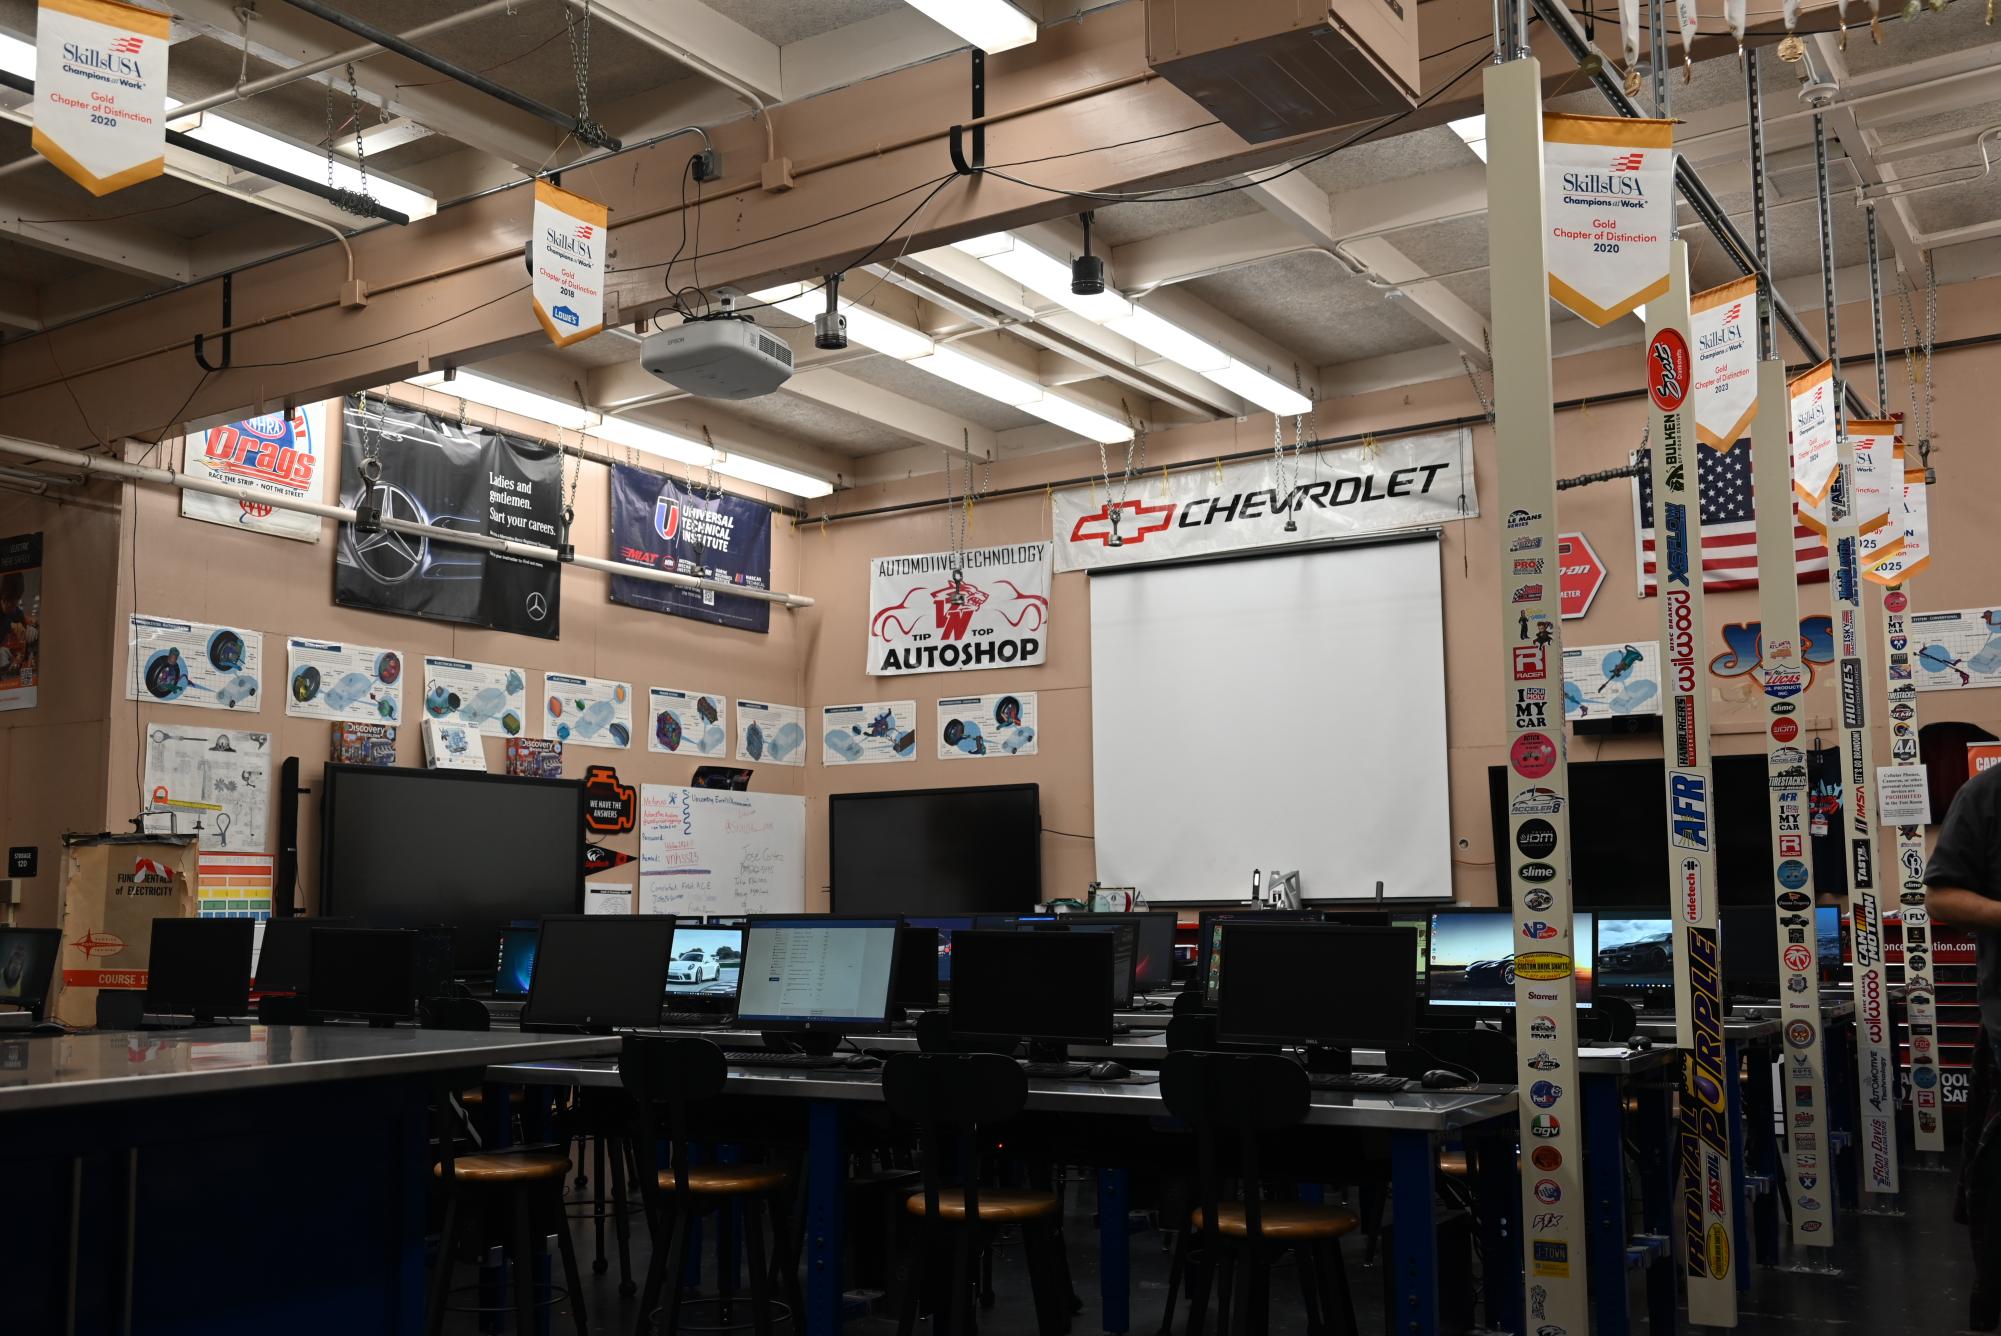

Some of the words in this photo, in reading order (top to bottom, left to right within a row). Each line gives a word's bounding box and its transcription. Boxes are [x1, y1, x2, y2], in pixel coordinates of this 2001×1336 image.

[63, 42, 143, 78] SkillsUSA
[62, 64, 110, 82] Champions
[91, 91, 115, 104] Gold
[50, 93, 89, 109] Chapter
[91, 102, 102, 112] of
[104, 105, 152, 124] Distinction
[91, 114, 117, 127] 2020
[1563, 172, 1644, 196] SkillsUSA
[1563, 196, 1612, 207] Champions
[1592, 219, 1616, 229] Gold
[547, 228, 592, 259] SkillsUSA
[1553, 228, 1592, 240] Chapter
[1594, 231, 1604, 240] of
[1606, 232, 1657, 242] Distinction
[546, 246, 573, 263] Champions
[1593, 243, 1620, 253] 2020
[539, 267, 561, 282] Chapter
[562, 277, 567, 285] of
[568, 281, 597, 297] Distinction
[561, 268, 575, 279] Gold
[560, 287, 575, 298] 2018
[554, 308, 577, 324] LOWE'S
[1699, 323, 1741, 351] SkillsUSA
[1700, 349, 1725, 361] Champions
[1715, 363, 1728, 374] Gold
[1695, 379, 1716, 390] Chapter
[1716, 376, 1721, 384] of
[1722, 368, 1749, 382] Distinction
[1715, 383, 1728, 394] 2023
[1664, 414, 1677, 465] BULKEN
[204, 427, 317, 480] Drags
[208, 472, 223, 481] RACE
[237, 478, 254, 487] STRIP
[260, 483, 273, 492] NOT
[274, 487, 284, 495] THE
[285, 489, 304, 498] STREET
[489, 472, 515, 489] Ladies
[516, 482, 532, 494] and
[489, 490, 532, 510] gentlemen.
[1178, 463, 1450, 528] CHEVROLET
[489, 507, 505, 525] Start
[507, 515, 527, 528] your
[528, 519, 556, 536] careers.
[682, 505, 734, 528] UNIVERSAL
[1519, 513, 1542, 522] MANS
[682, 517, 731, 540] TECHNICAL
[682, 530, 729, 552] INSTITUTE
[879, 555, 956, 577] AUTOMOTIVE
[961, 544, 1045, 569] TECHNOLOGY
[972, 628, 994, 637] TOP
[1667, 589, 1695, 692] wilwood
[1843, 623, 1851, 642] ISKY
[880, 638, 1039, 670] AUTOSHOP
[1767, 674, 1800, 685] LUCAS
[1517, 689, 1525, 702] I
[1843, 663, 1856, 725] HUGHES
[1516, 702, 1547, 717] MY
[348, 722, 385, 736] Discovery
[1516, 717, 1547, 728] CAR
[1676, 697, 1689, 766] HAMBURGERS
[1893, 740, 1916, 754] 44
[590, 800, 598, 808] WE
[598, 800, 612, 809] HAVE
[612, 801, 622, 809] THE
[1779, 792, 1798, 801] AFR
[593, 809, 618, 818] ANSWERS
[1672, 775, 1707, 846] AFR
[1779, 814, 1800, 824] MY
[1780, 806, 1785, 814] I
[1522, 866, 1553, 877] slime
[115, 886, 123, 895] of
[127, 886, 173, 896] ELECTRICITY
[1686, 873, 1697, 920] ridetech
[1903, 911, 1907, 920] I
[1910, 910, 1926, 921] FLY
[1524, 921, 1546, 939] VP
[1865, 895, 1878, 960] MOTION
[1856, 932, 1870, 966] CAM
[99, 974, 136, 984] COURSE
[1528, 991, 1558, 1001] Starrett
[1864, 969, 1882, 1044] wilwood
[1689, 928, 1729, 1160] PURPLE
[1533, 1127, 1558, 1137] agv
[1871, 1119, 1882, 1152] Davis
[1873, 1153, 1884, 1178] Ron
[1681, 1103, 1707, 1277] ROYAL
[1707, 1153, 1725, 1218] AMSOIL
